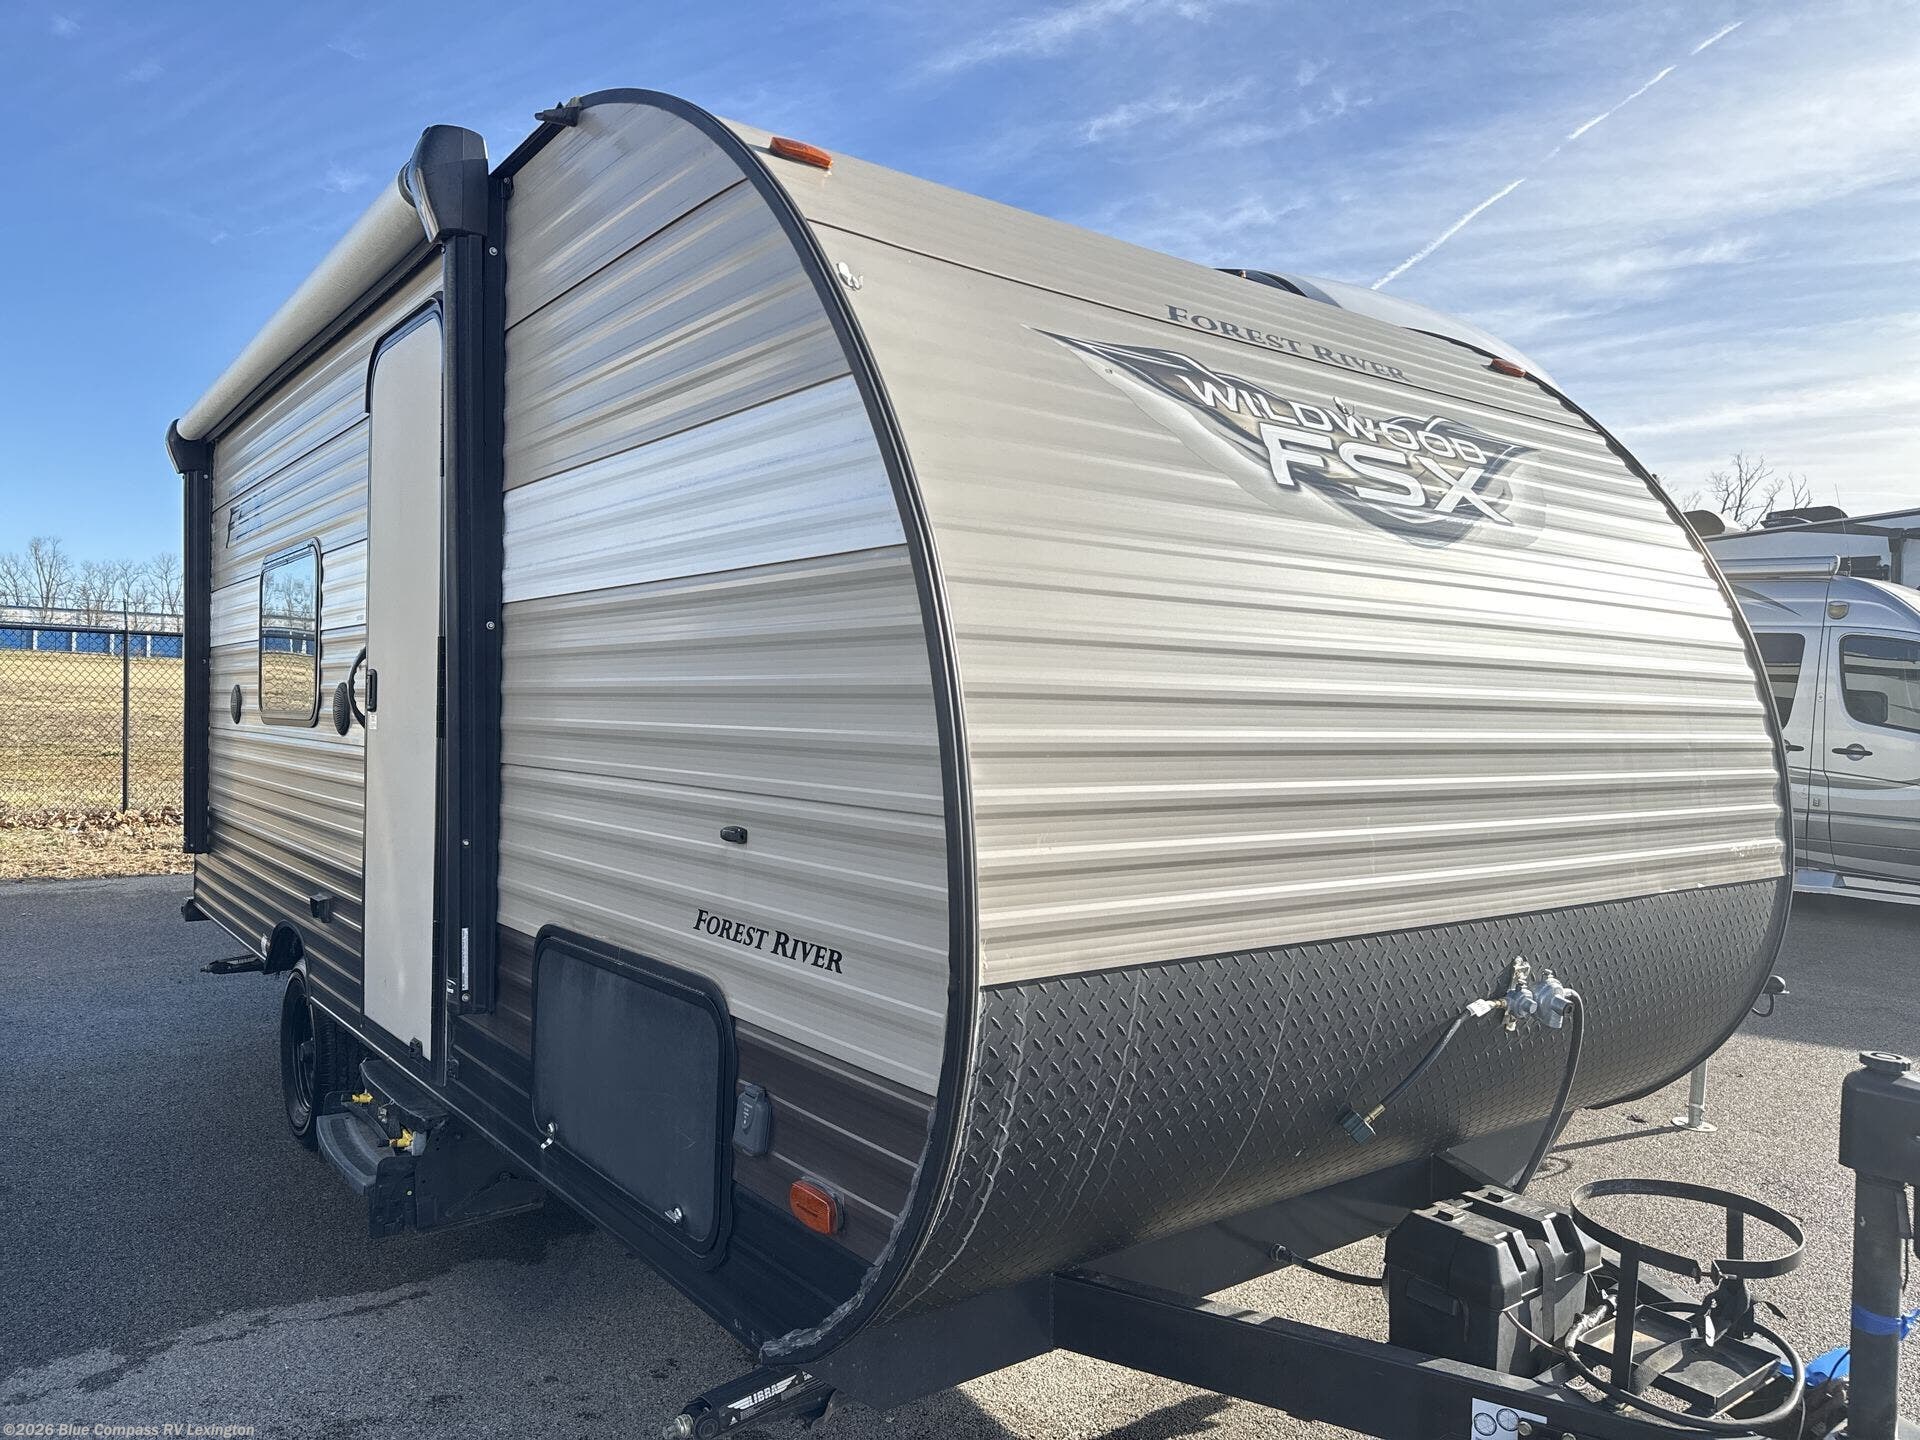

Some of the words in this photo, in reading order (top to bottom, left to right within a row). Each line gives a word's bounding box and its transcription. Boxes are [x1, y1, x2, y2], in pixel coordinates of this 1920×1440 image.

[1165, 304, 1302, 354] FOREST
[1311, 344, 1413, 383] RIVER
[1176, 375, 1488, 465] WILDWOOD
[1259, 422, 1513, 525] FSX
[693, 908, 770, 950] FOREST
[770, 930, 844, 975] RIVER
